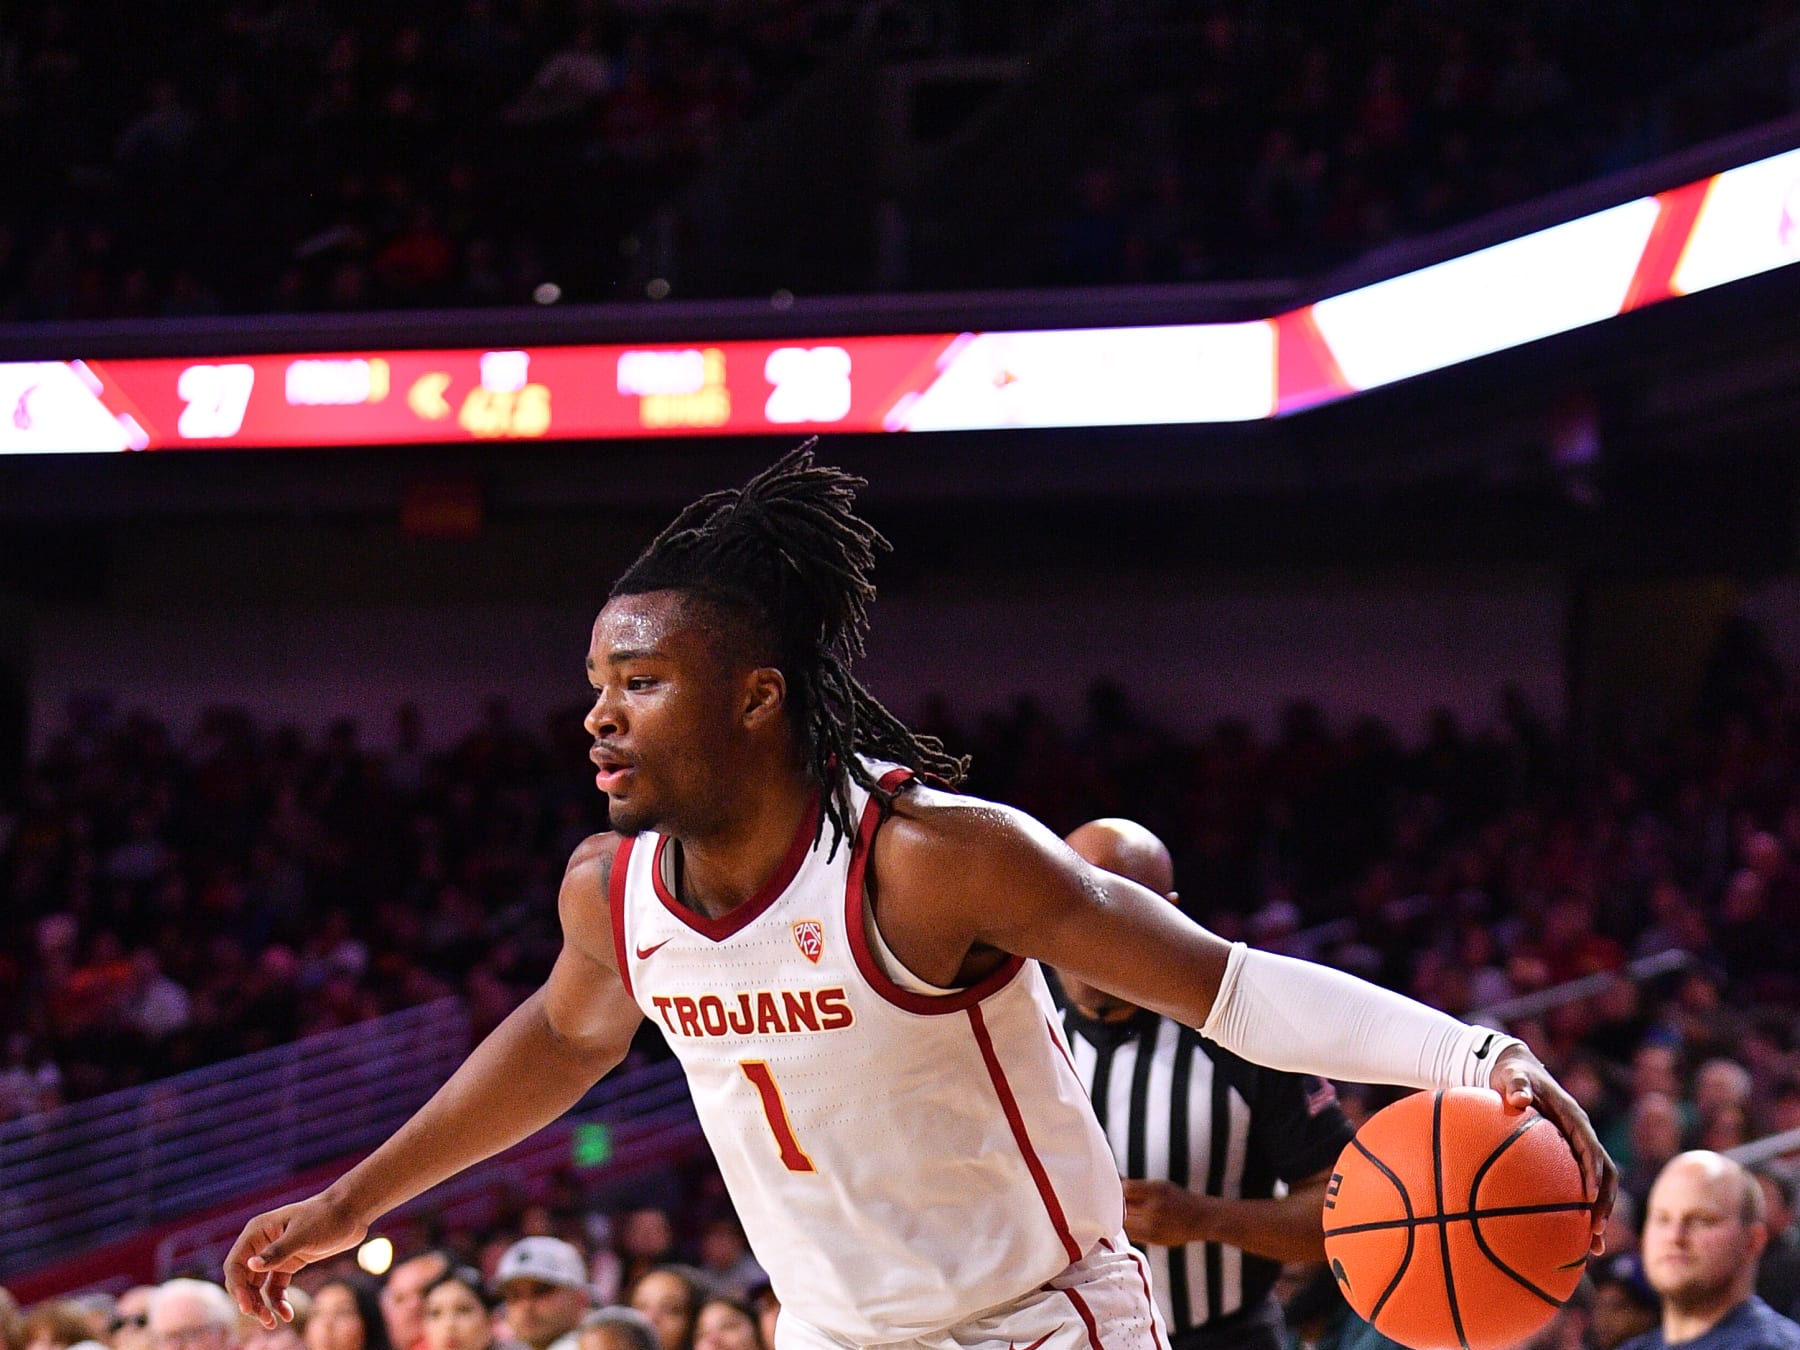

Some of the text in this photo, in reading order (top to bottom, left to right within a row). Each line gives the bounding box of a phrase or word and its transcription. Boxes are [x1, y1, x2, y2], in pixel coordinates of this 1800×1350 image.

[794, 922, 822, 947] PAC
[803, 939, 819, 955] 12
[652, 987, 854, 1037] TROJANS
[739, 1059, 816, 1172] 1
